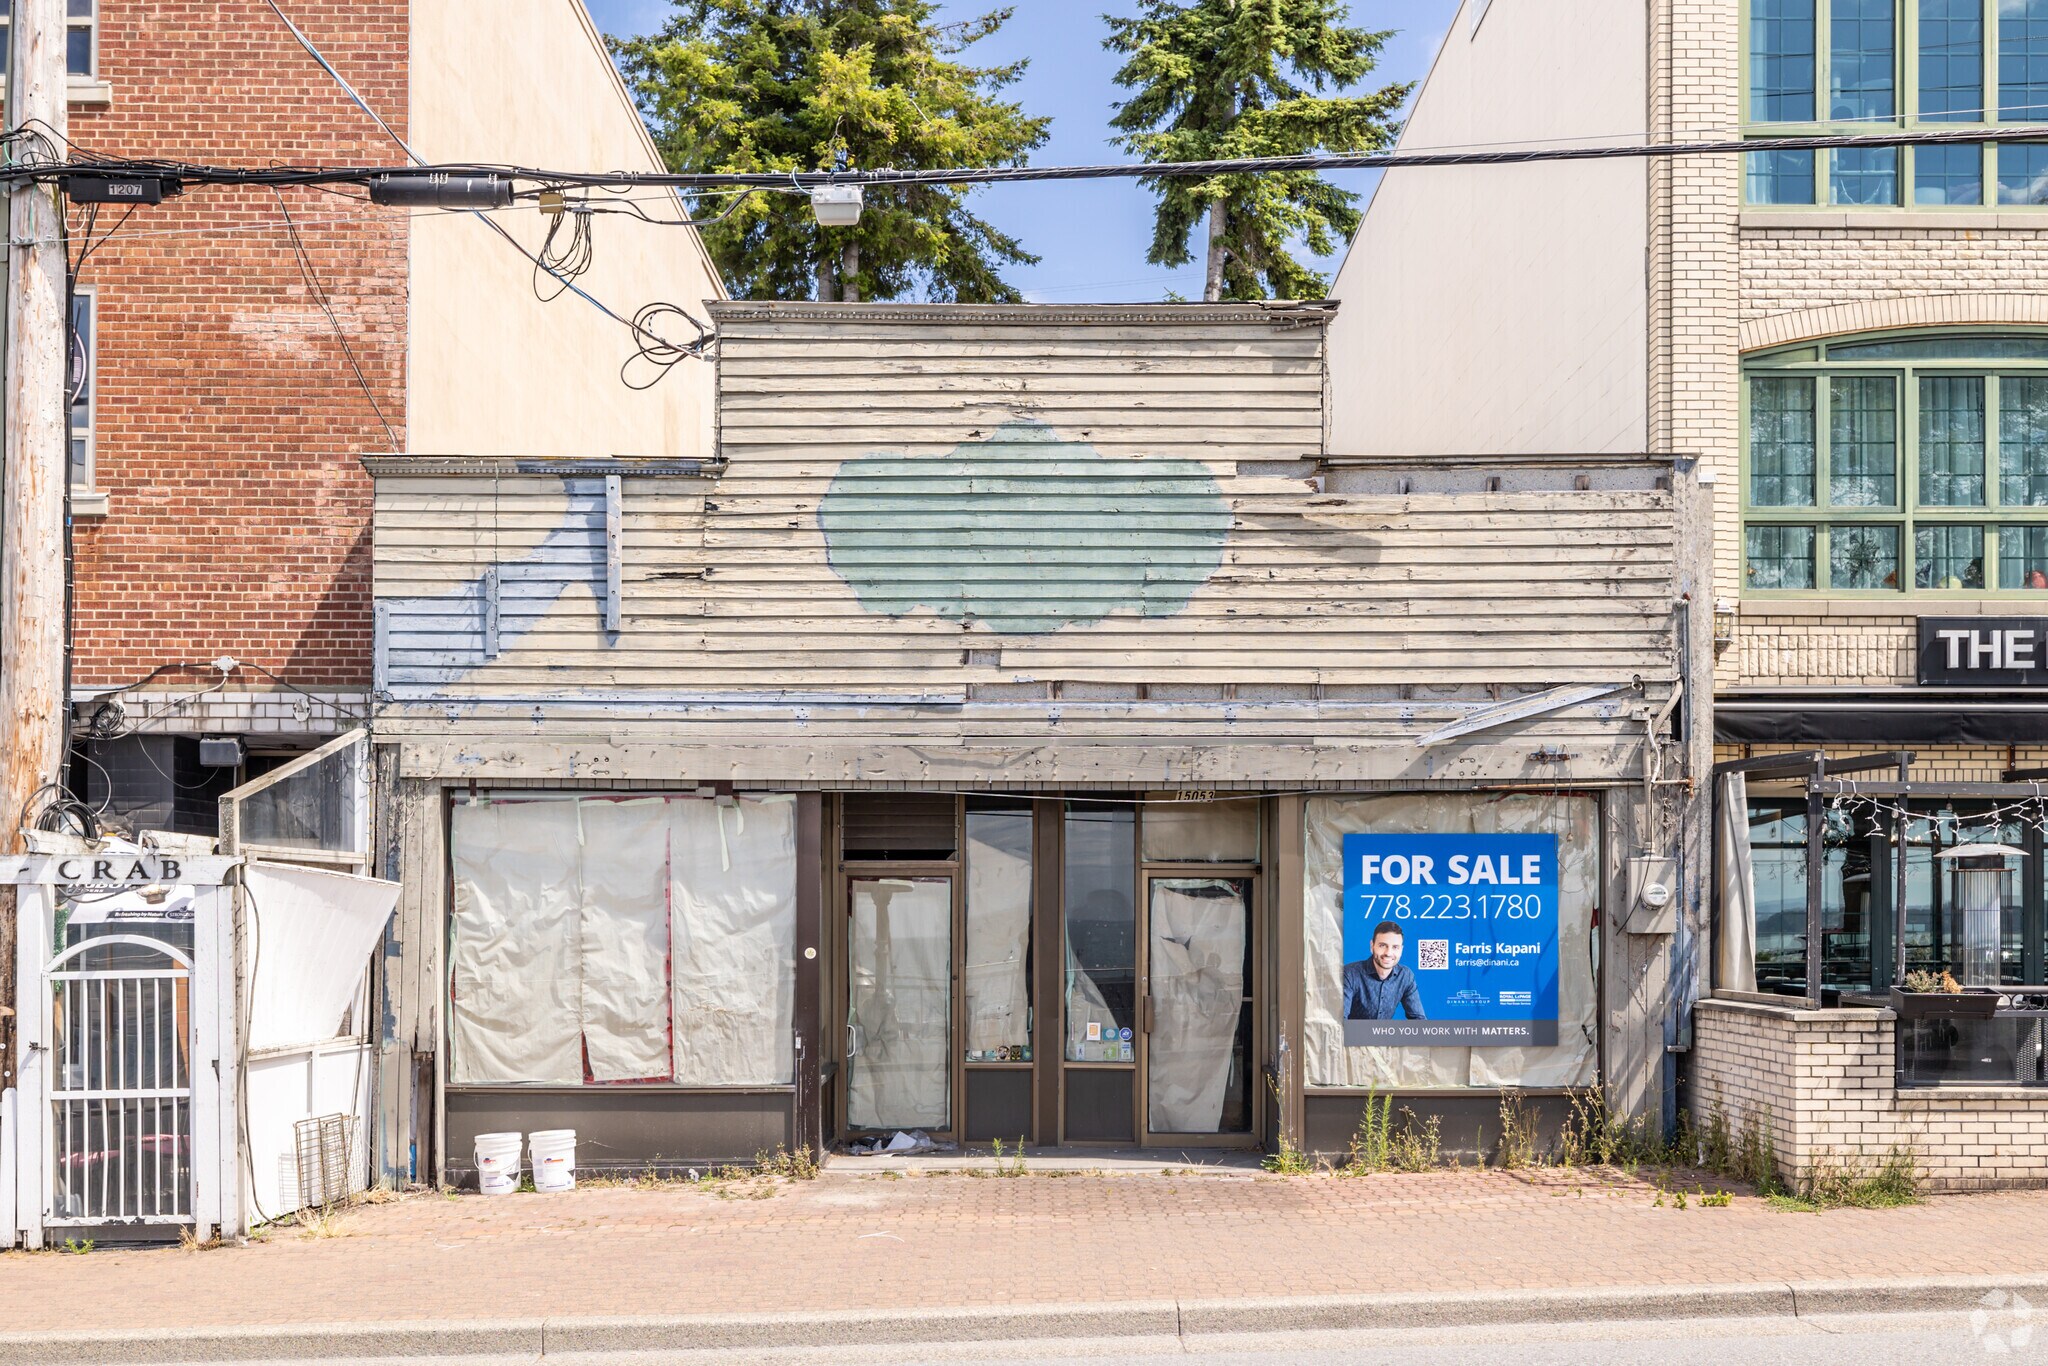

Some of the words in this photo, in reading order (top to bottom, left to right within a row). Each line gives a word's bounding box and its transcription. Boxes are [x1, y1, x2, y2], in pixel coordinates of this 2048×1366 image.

[109, 185, 141, 195] 1207
[1936, 630, 2035, 669] THE
[1178, 791, 1214, 802] 15053
[58, 859, 181, 880] CRAB
[1362, 855, 1437, 885] FOR
[1448, 855, 1541, 885] SALE
[1361, 894, 1541, 919] 778.223.1780
[1455, 942, 1491, 954] Farris
[1496, 942, 1541, 957] Kapani
[1455, 958, 1519, 967] farris@dinani.ca
[1372, 1027, 1395, 1035] WHO
[1398, 1027, 1419, 1035] YOU
[1422, 1027, 1450, 1035] WORK
[1453, 1027, 1478, 1035] WITH
[1481, 1027, 1530, 1035] MATTERS.
